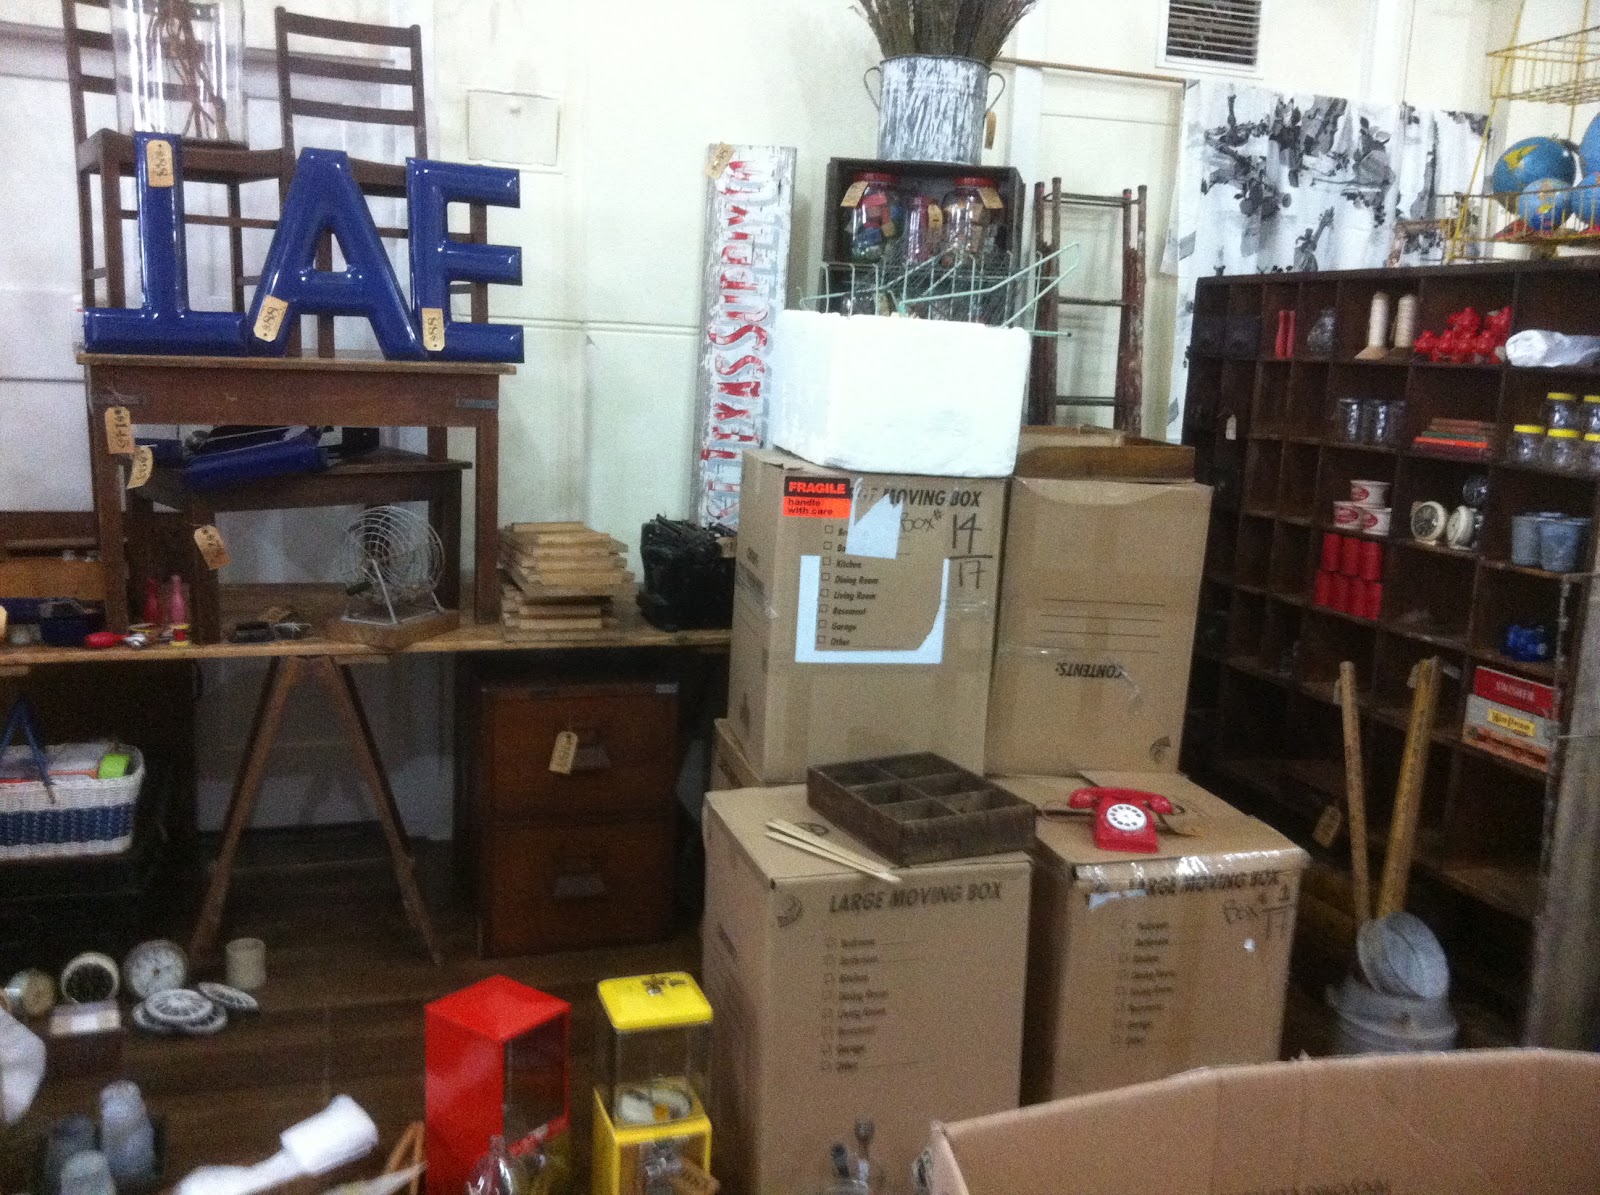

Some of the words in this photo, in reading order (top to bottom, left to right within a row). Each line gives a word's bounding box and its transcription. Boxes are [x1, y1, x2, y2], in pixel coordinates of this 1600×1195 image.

[788, 481, 847, 495] FRAGILE
[883, 488, 946, 506] MOVING
[950, 490, 983, 507] BOX
[788, 498, 821, 507] handle
[952, 513, 983, 554] 14
[958, 559, 987, 589] 17
[833, 591, 855, 602] Living
[829, 891, 883, 913] LARGE
[889, 885, 963, 908] MOVING
[967, 881, 1001, 901] BOX
